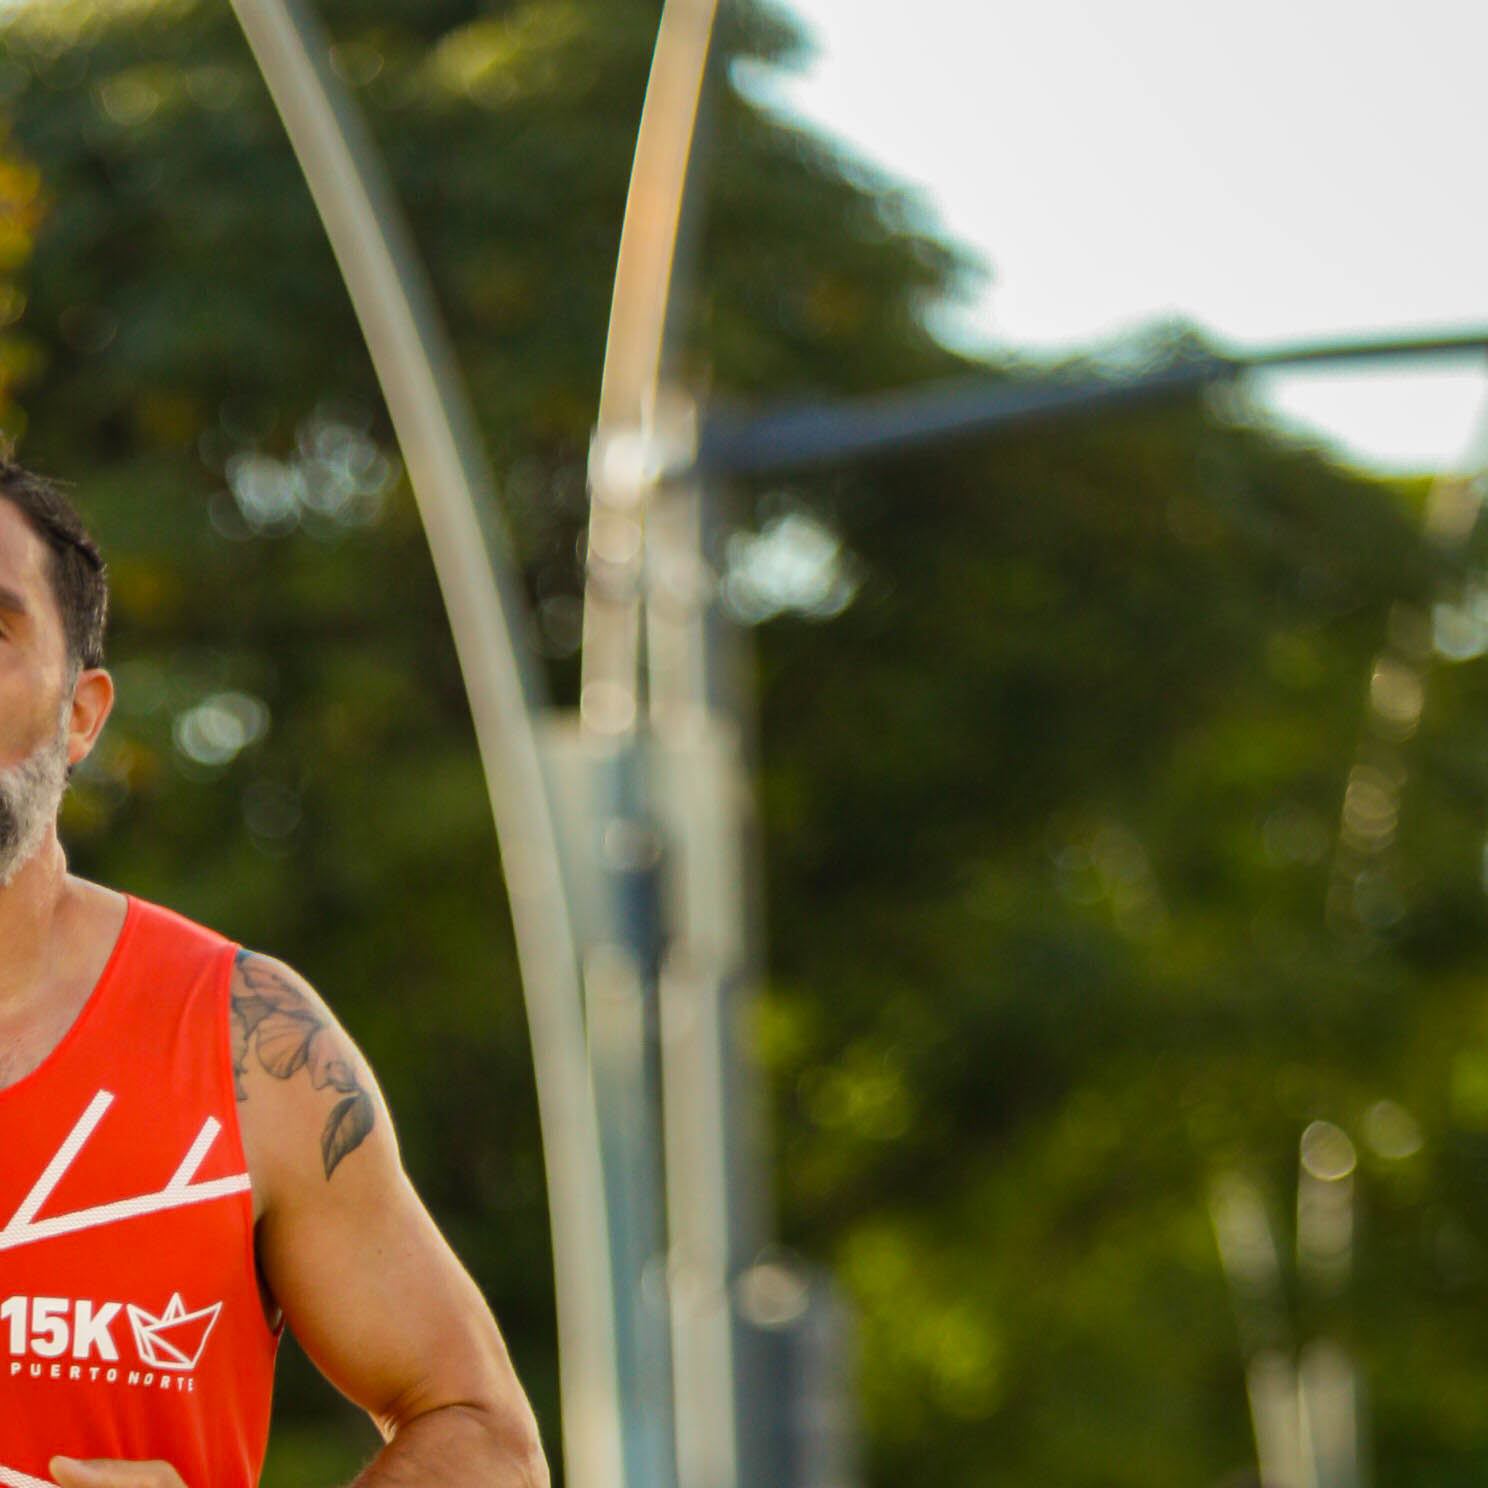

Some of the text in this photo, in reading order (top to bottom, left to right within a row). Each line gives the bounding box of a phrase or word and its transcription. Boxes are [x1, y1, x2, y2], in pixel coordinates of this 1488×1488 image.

[0, 1295, 123, 1361] 15K
[10, 1361, 195, 1392] PUERTO NORTE
